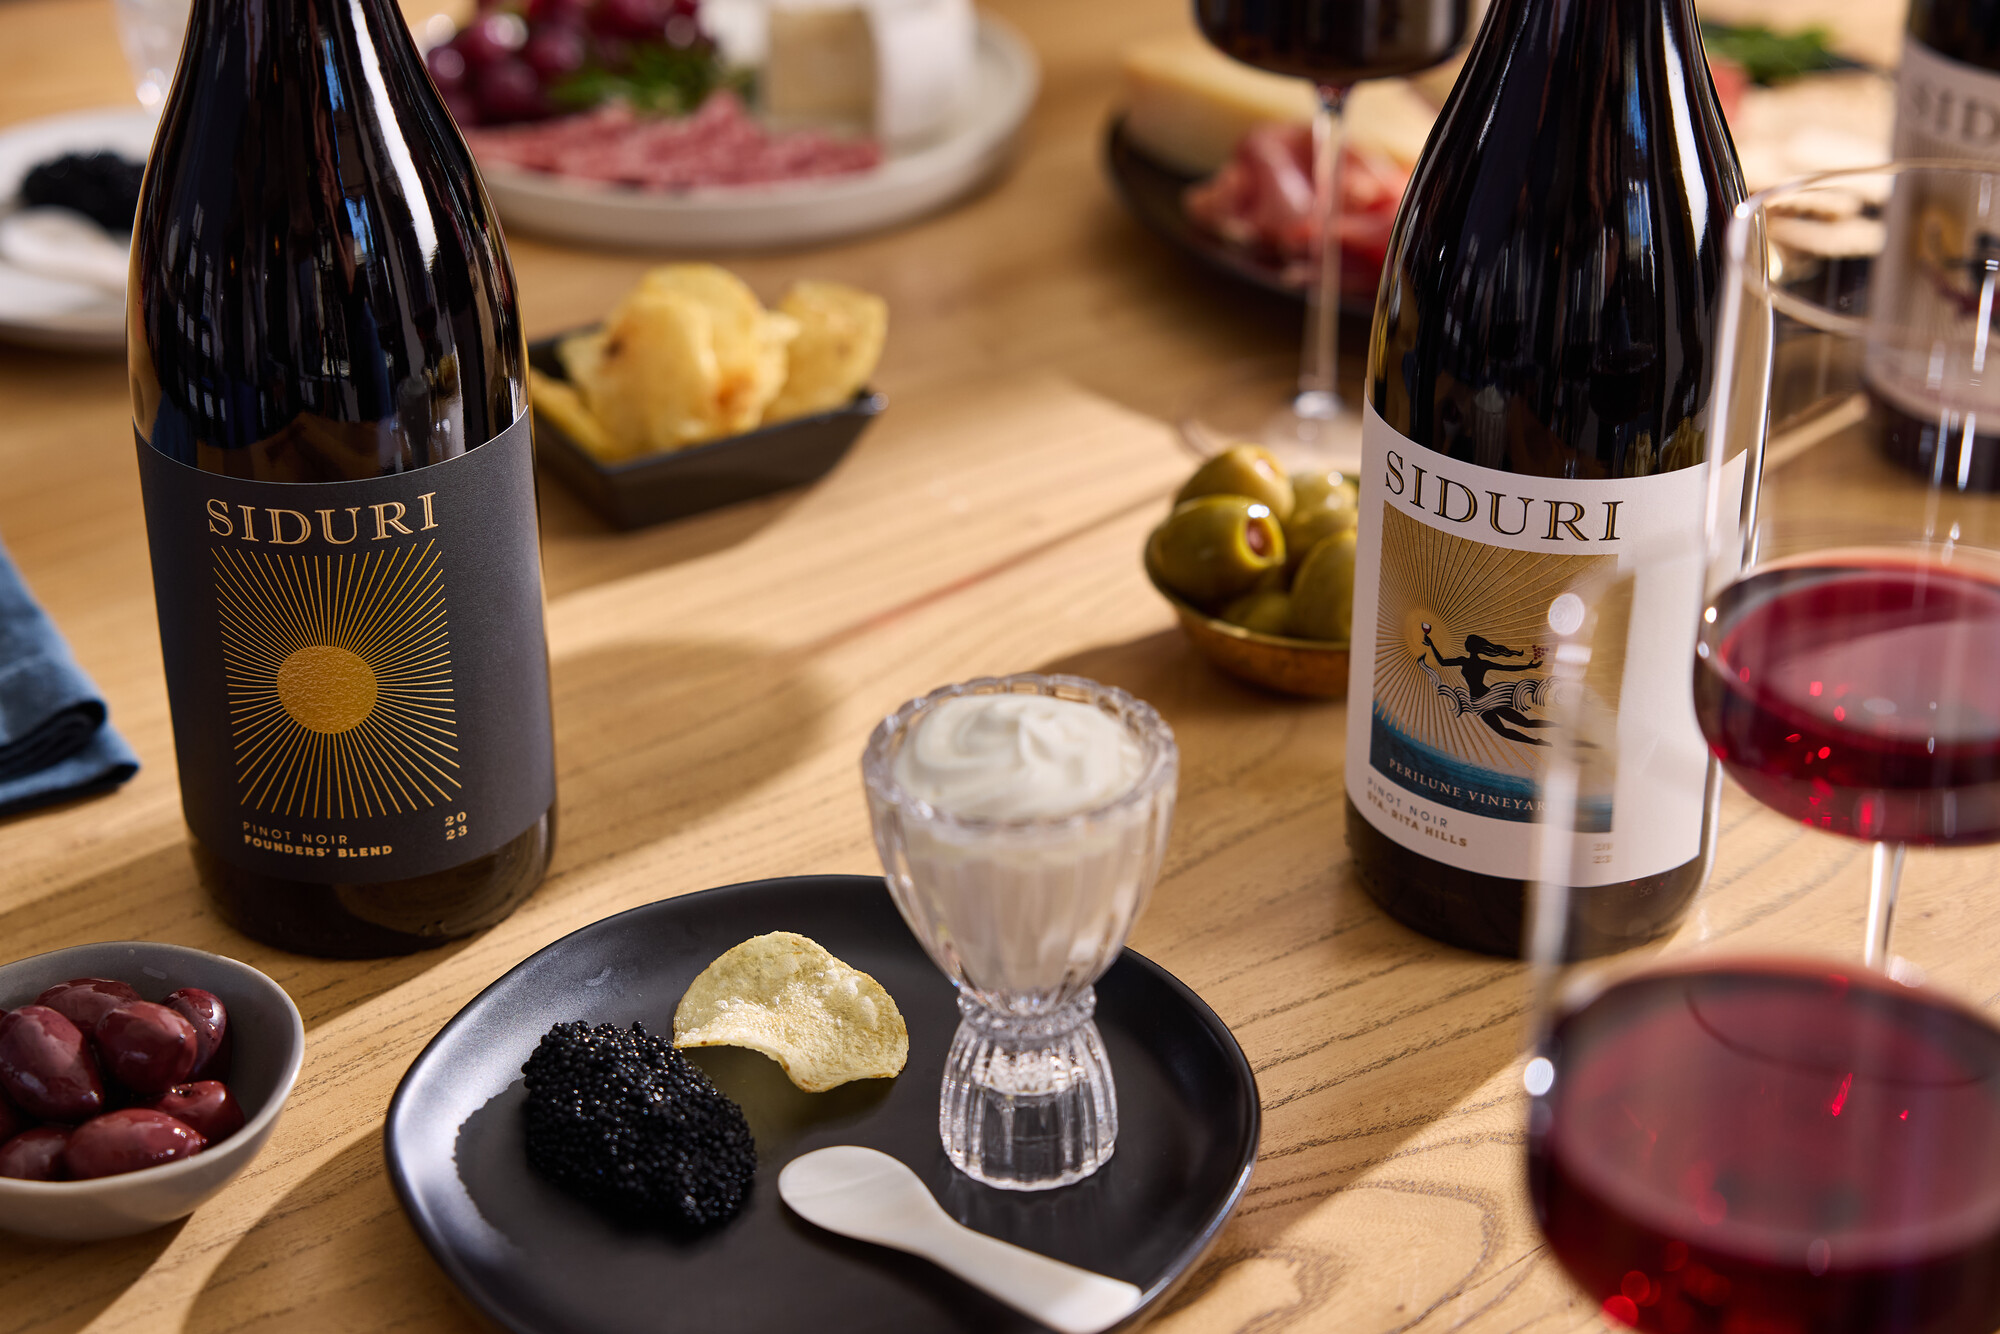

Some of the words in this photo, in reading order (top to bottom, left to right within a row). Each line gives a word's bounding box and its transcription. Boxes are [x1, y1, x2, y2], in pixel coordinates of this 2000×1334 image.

[1385, 450, 1624, 542] SIDURI
[206, 491, 439, 545] SIDURI
[1367, 776, 1401, 808] PINOT
[1409, 805, 1448, 828] NOIR
[1388, 757, 1462, 798] PERILUNE
[1468, 790, 1549, 812] VINEYAR
[243, 821, 292, 841] PINOT
[302, 833, 348, 845] NOIR
[445, 811, 467, 827] 20
[445, 825, 468, 841] 23
[1391, 809, 1419, 831] RITA
[1425, 825, 1468, 847] HILLS
[338, 845, 393, 858] BLEND
